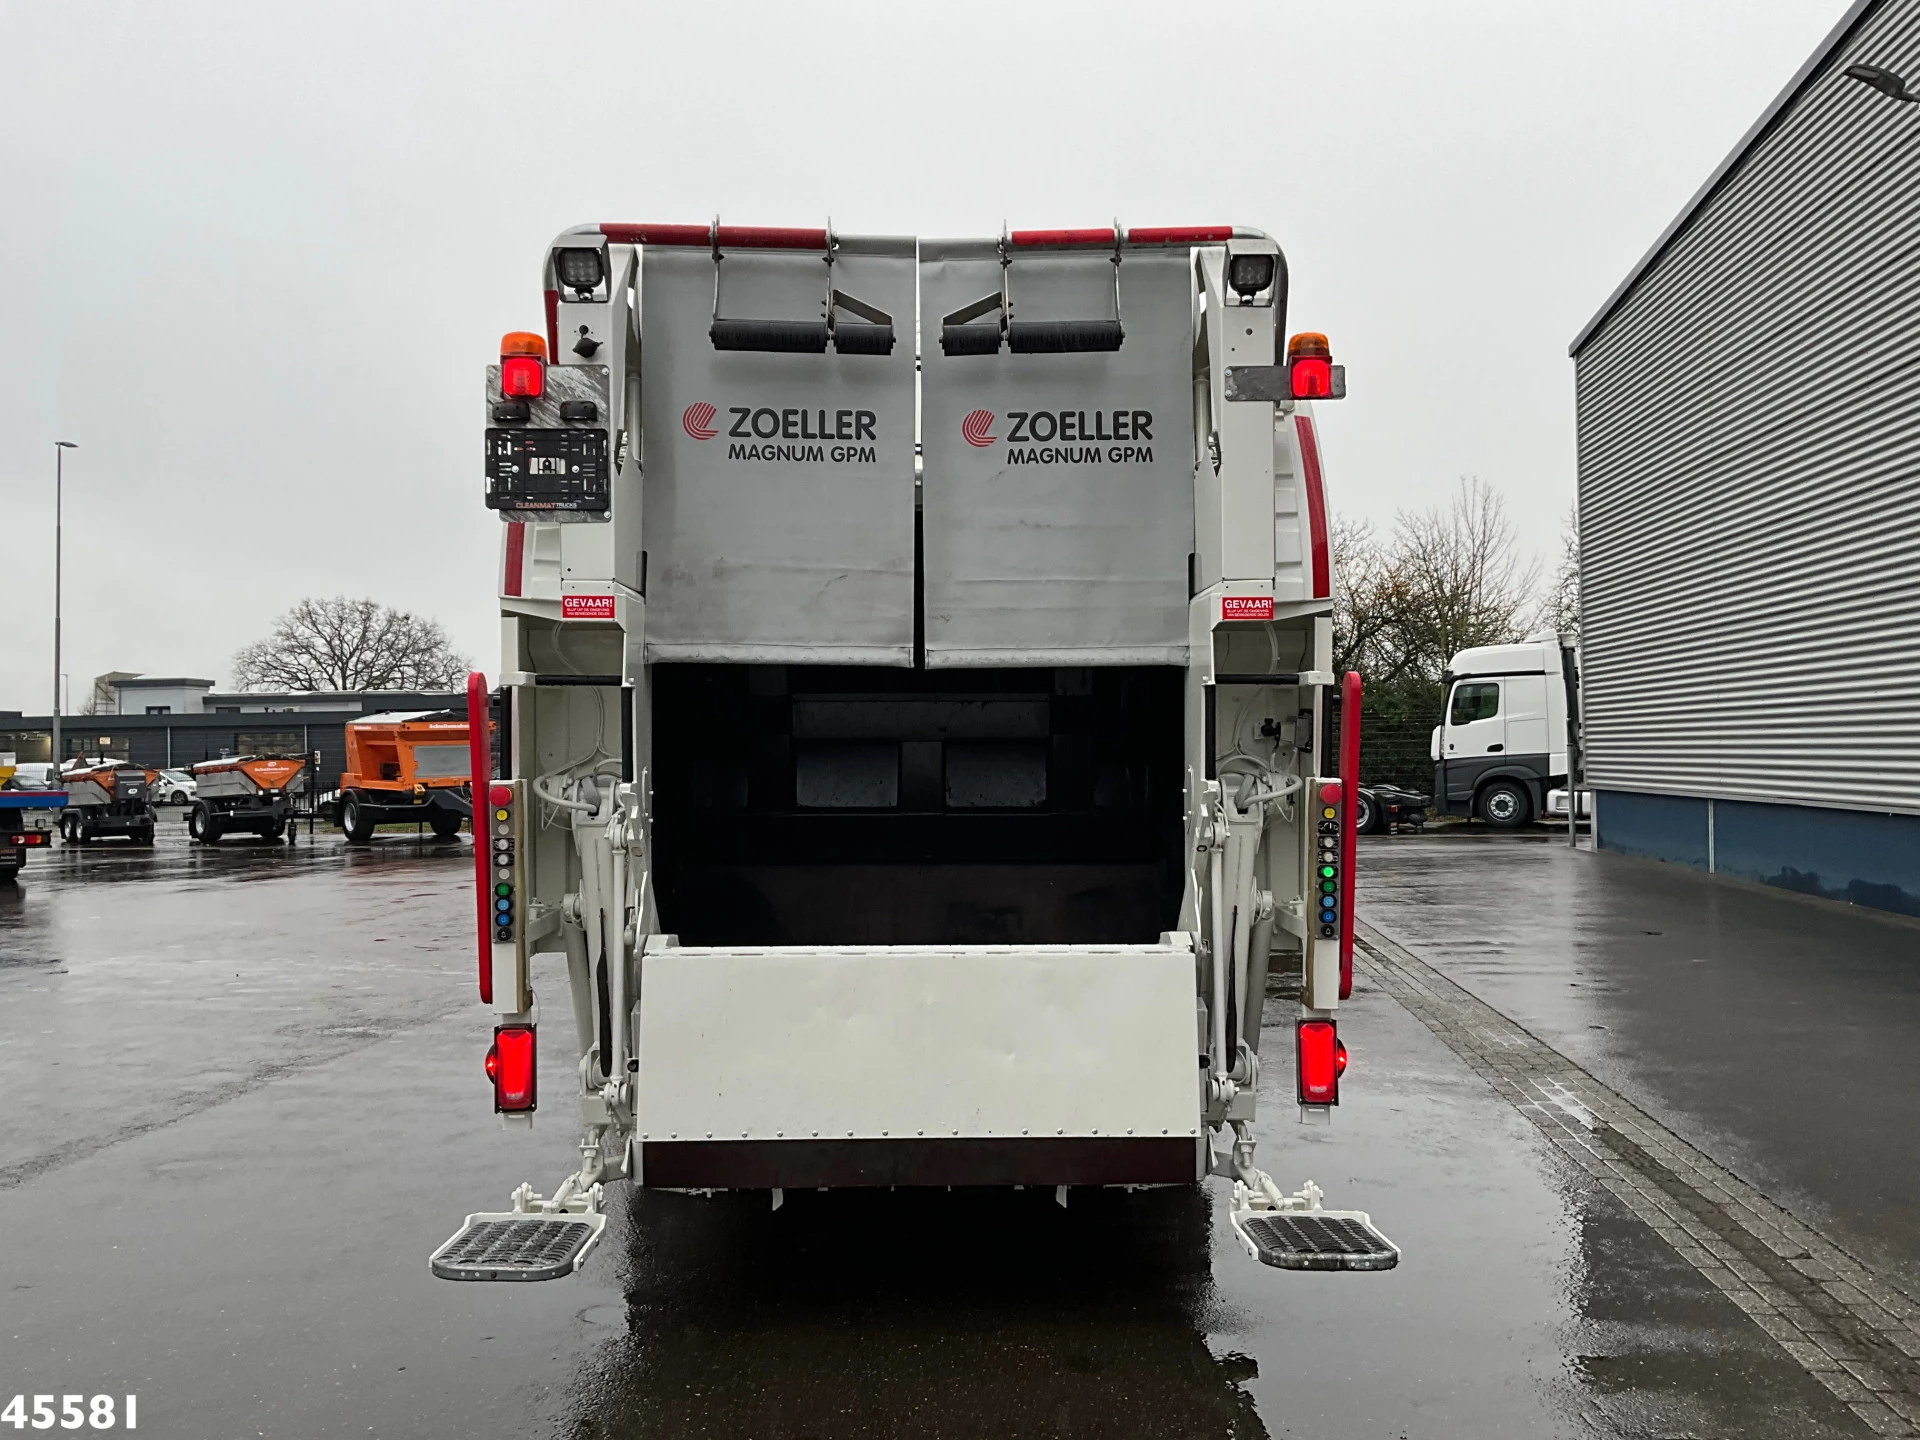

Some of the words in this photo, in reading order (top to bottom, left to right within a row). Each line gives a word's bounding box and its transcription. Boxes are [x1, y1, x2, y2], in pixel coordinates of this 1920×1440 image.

[728, 407, 876, 440] ZOELLER
[1006, 410, 1153, 442] ZOELLER
[728, 443, 824, 462] MAGNUM
[830, 446, 876, 463] GPM
[1007, 447, 1102, 464] MAGNUM
[1108, 446, 1153, 463] GPM
[564, 598, 613, 607] GEVAAR!
[1224, 599, 1272, 609] GEVAAR!
